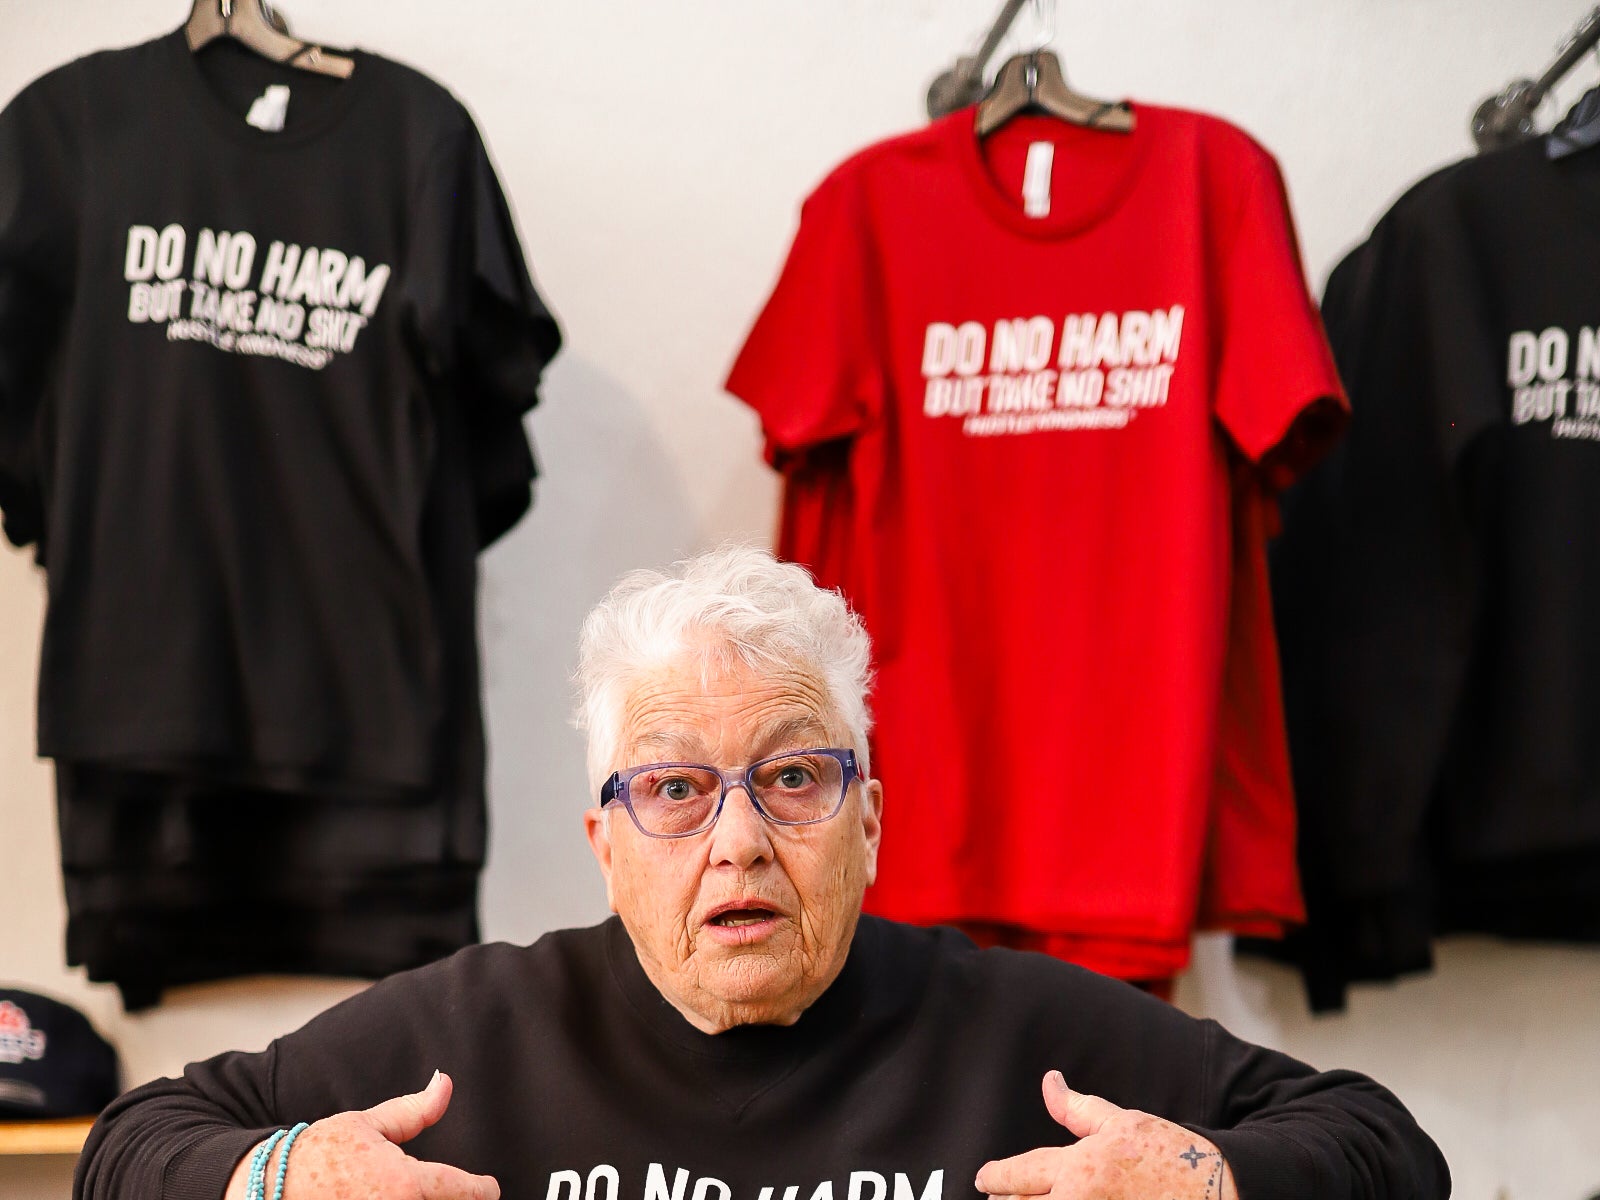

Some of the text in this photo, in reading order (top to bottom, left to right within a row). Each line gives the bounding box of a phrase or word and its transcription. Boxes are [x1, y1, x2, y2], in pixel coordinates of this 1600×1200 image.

[124, 223, 391, 317] DO NO HARM
[127, 278, 187, 323] BUT
[189, 279, 257, 333] TAKE
[255, 296, 305, 341] NO
[304, 305, 368, 353] SHIT
[921, 304, 1185, 378] DO NO HARM
[1055, 366, 1105, 408] NO
[1103, 363, 1175, 409] SHIT
[1507, 326, 1569, 388] DO
[1511, 378, 1573, 425] BUT
